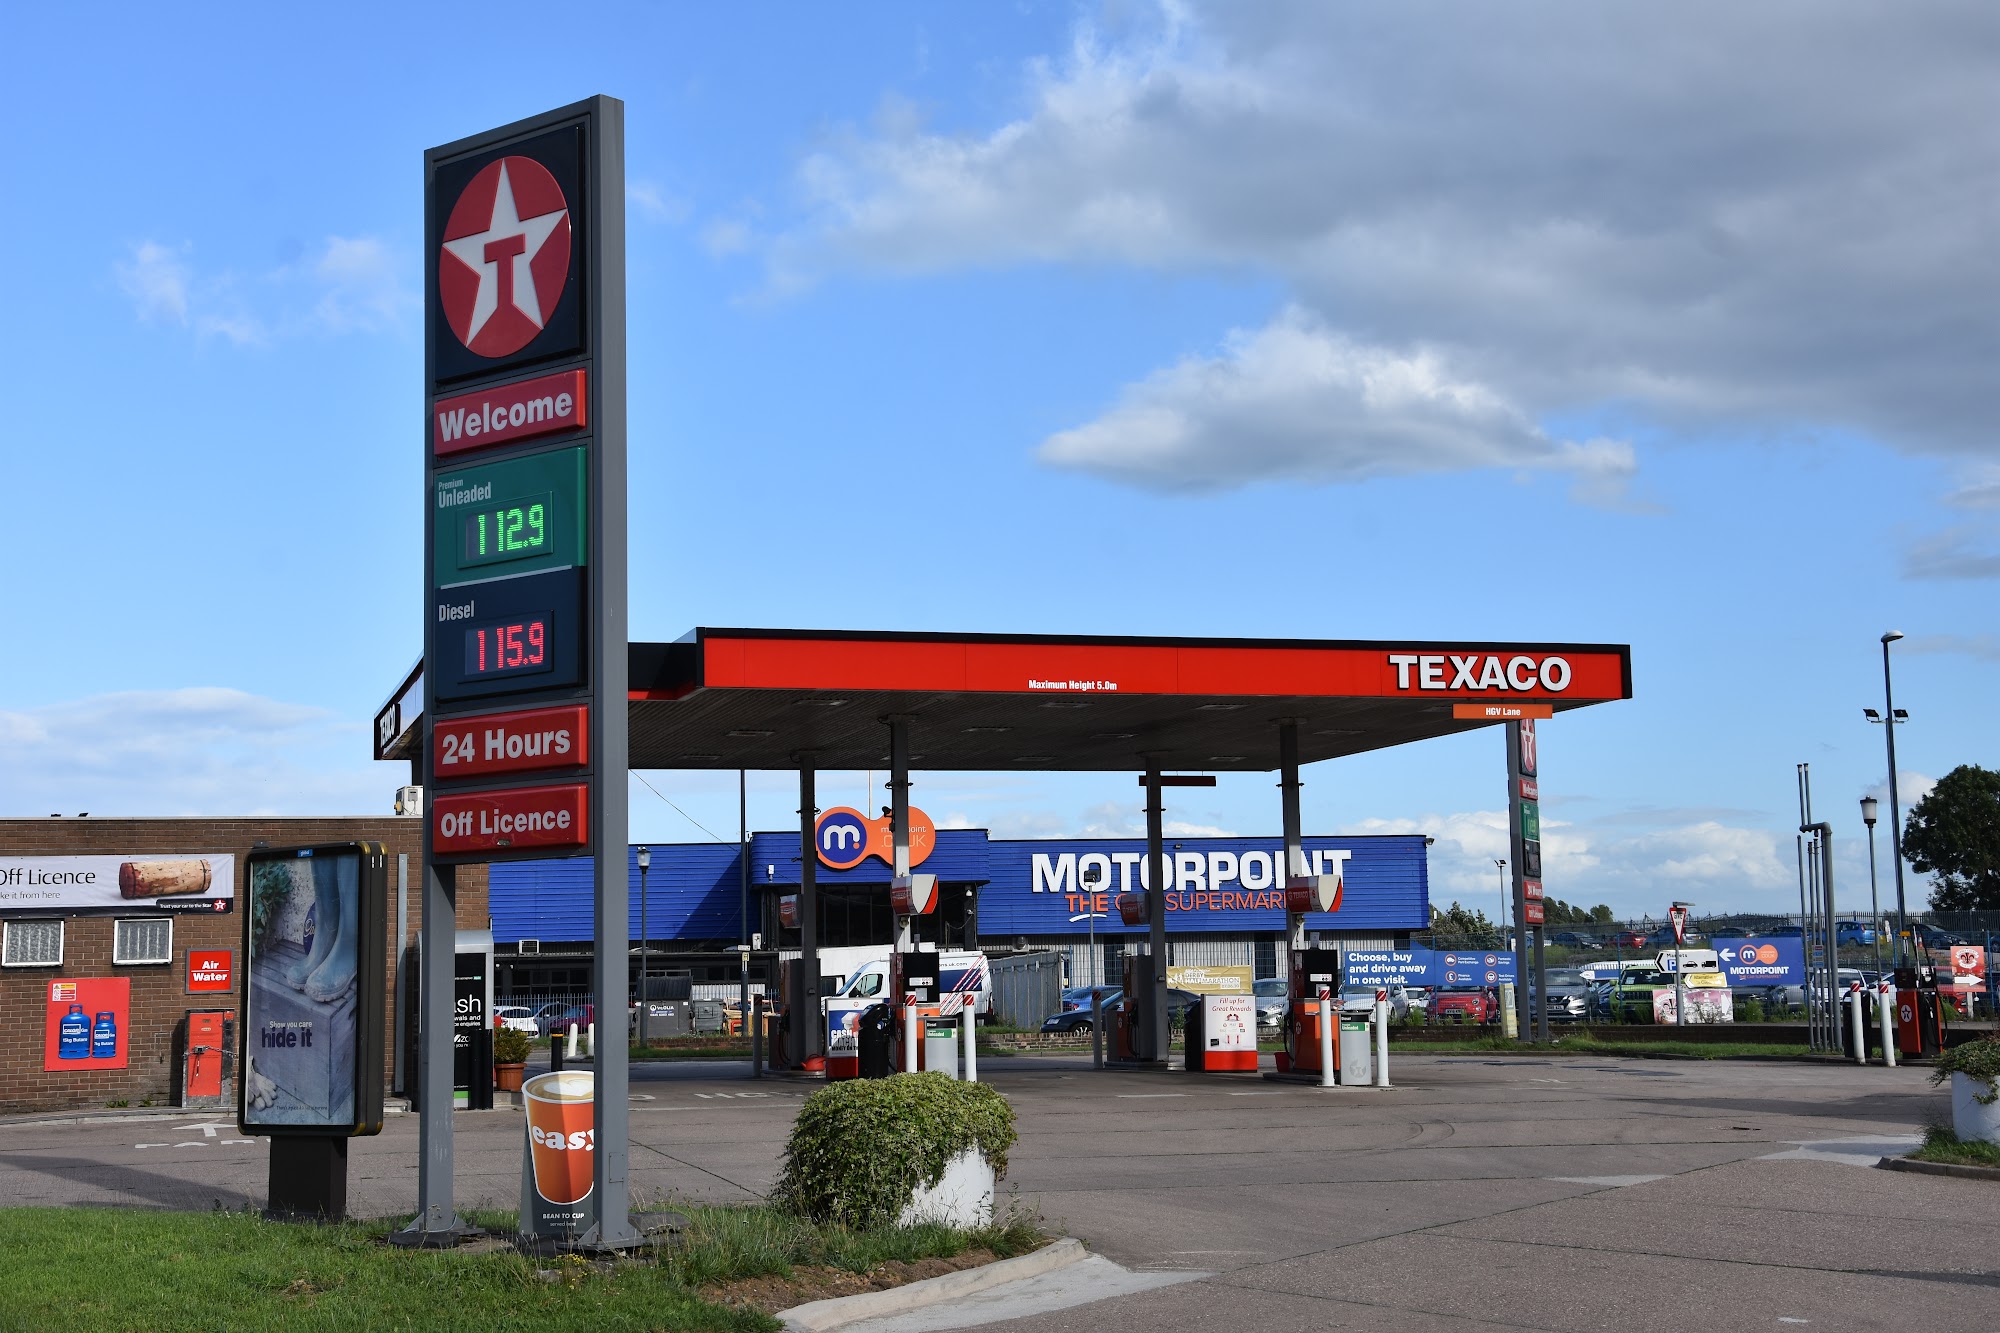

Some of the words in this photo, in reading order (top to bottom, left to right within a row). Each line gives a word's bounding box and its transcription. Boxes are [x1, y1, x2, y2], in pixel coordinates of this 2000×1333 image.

[439, 392, 573, 443] Welcome
[438, 479, 464, 491] Premium
[438, 482, 491, 508] Unleaded
[478, 504, 544, 555] 112.9
[438, 600, 475, 622] Diesel
[478, 622, 544, 671] 115.9
[1389, 654, 1572, 692] TEXACO
[1028, 680, 1067, 689] Maximum
[1069, 681, 1095, 691] Height
[1097, 681, 1117, 690] 5.0m
[1485, 707, 1501, 716] HGV
[1503, 707, 1521, 716] Lane
[441, 732, 475, 765] 24
[485, 729, 571, 760] Hours
[441, 811, 473, 838] Off
[480, 808, 571, 835] Licence
[28, 869, 96, 885] Licence
[20, 891, 40, 899] from
[42, 891, 60, 899] here
[1065, 894, 1109, 912] THE
[1165, 891, 1287, 911] SUPERMAR
[202, 961, 220, 969] Air
[1349, 953, 1391, 963] Choose,
[1393, 953, 1412, 963] buy
[193, 973, 227, 981] Water
[1349, 964, 1369, 973] and
[1371, 964, 1397, 973] drive
[1399, 965, 1426, 974] away
[1729, 966, 1790, 975] MOTORPOINT
[1350, 976, 1359, 984] in
[1383, 975, 1408, 984] visit.
[454, 994, 481, 1013] sh
[270, 1021, 286, 1029] Show
[261, 1027, 297, 1048] hide
[301, 1027, 312, 1048] it
